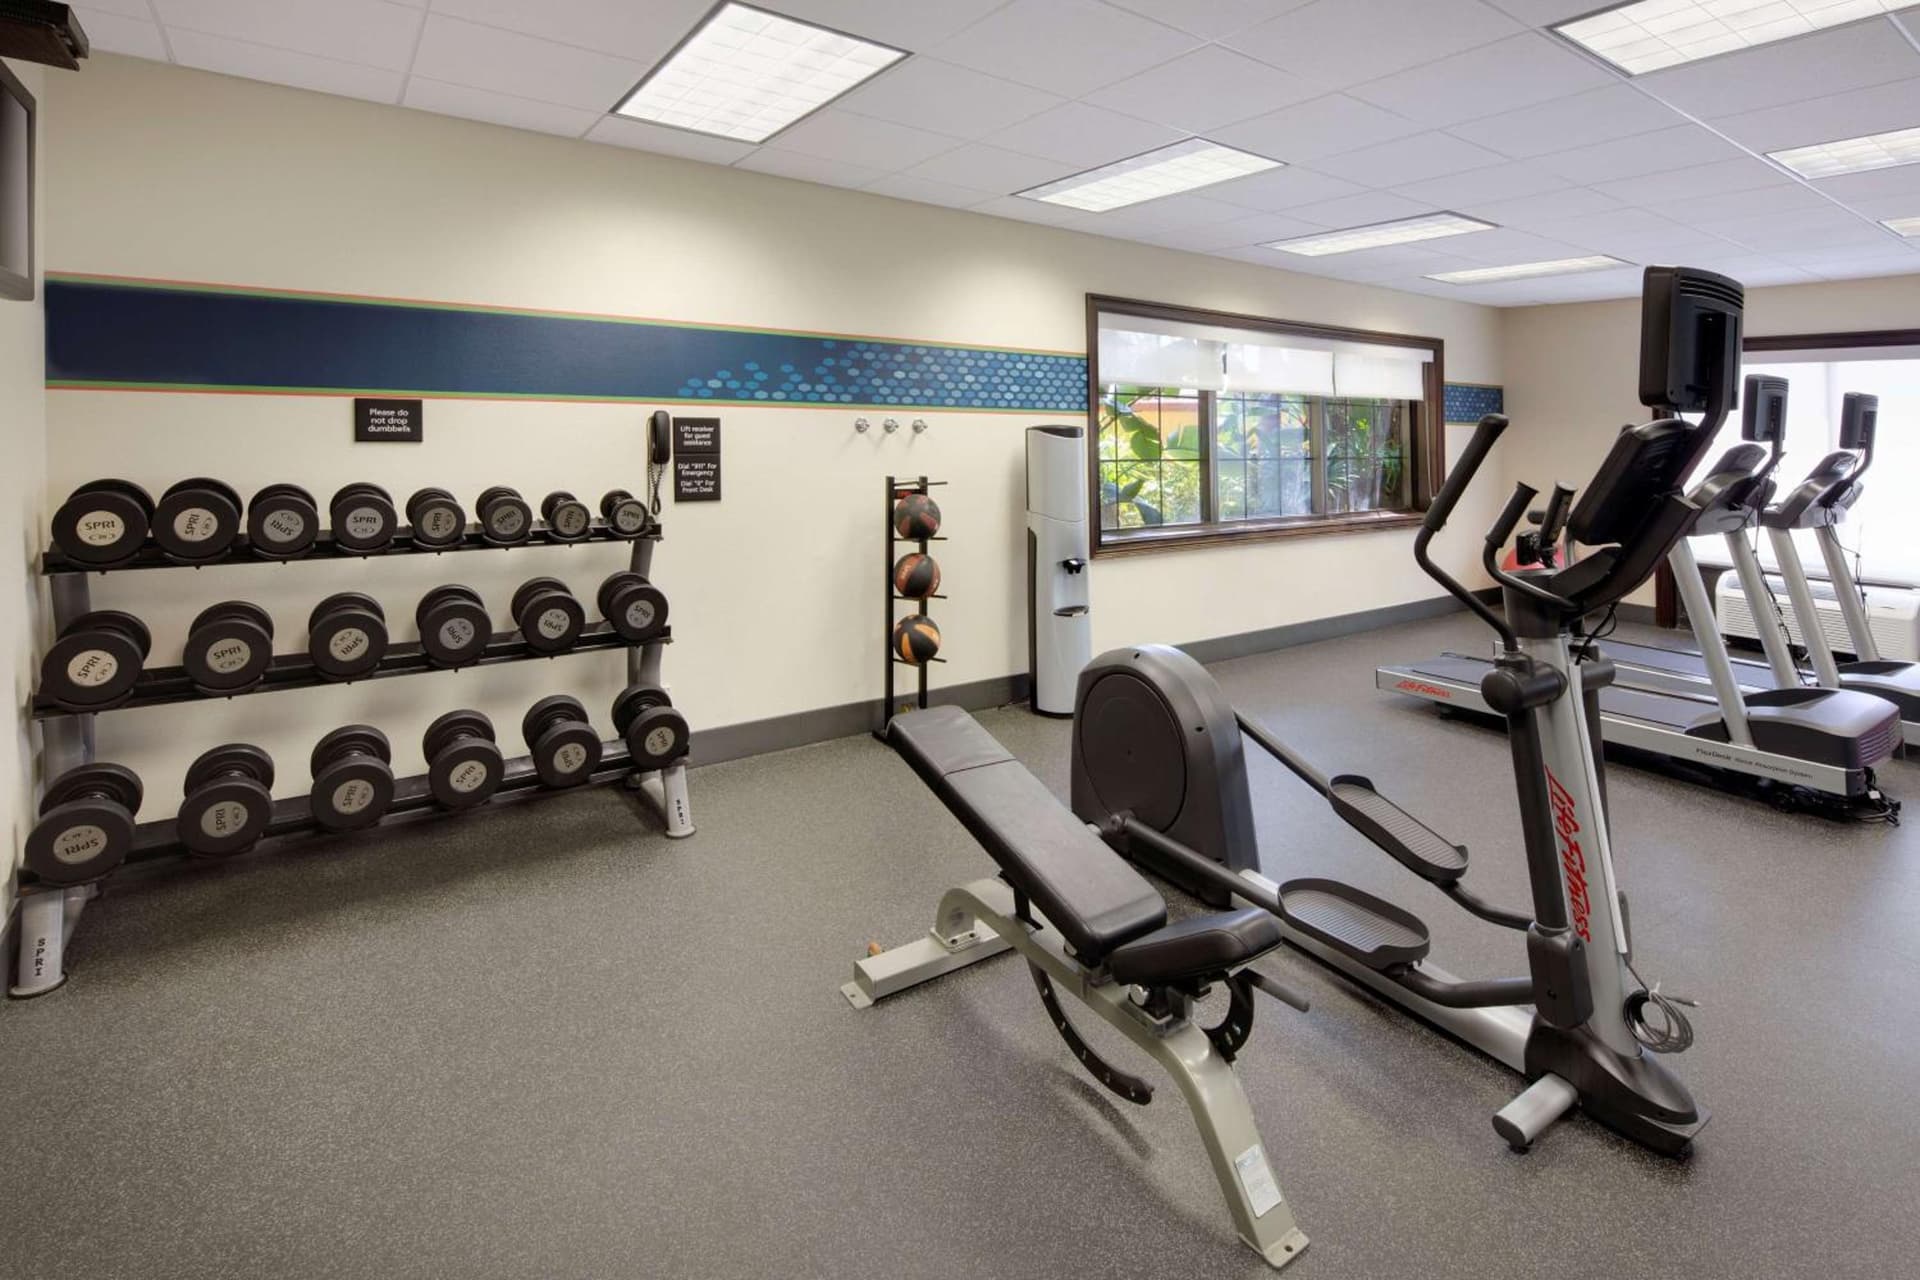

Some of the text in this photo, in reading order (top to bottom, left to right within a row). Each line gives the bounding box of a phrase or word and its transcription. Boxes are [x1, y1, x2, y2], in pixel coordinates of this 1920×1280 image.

[369, 408, 395, 416] Please
[387, 417, 408, 426] drop
[432, 512, 441, 532] SPRI
[622, 510, 640, 520] SPRI
[85, 520, 115, 531] SPRI
[185, 514, 200, 535] SPRI
[271, 520, 294, 536] SPRI
[446, 626, 463, 643] SPRI
[213, 646, 241, 660] SPRI
[341, 636, 363, 655] SPRI
[77, 655, 100, 679] SPRI
[456, 765, 476, 784] SPRI
[342, 784, 357, 806] SPRI
[215, 809, 227, 831] SPRI
[65, 839, 99, 856] SPRI
[35, 938, 46, 976] SPRI
